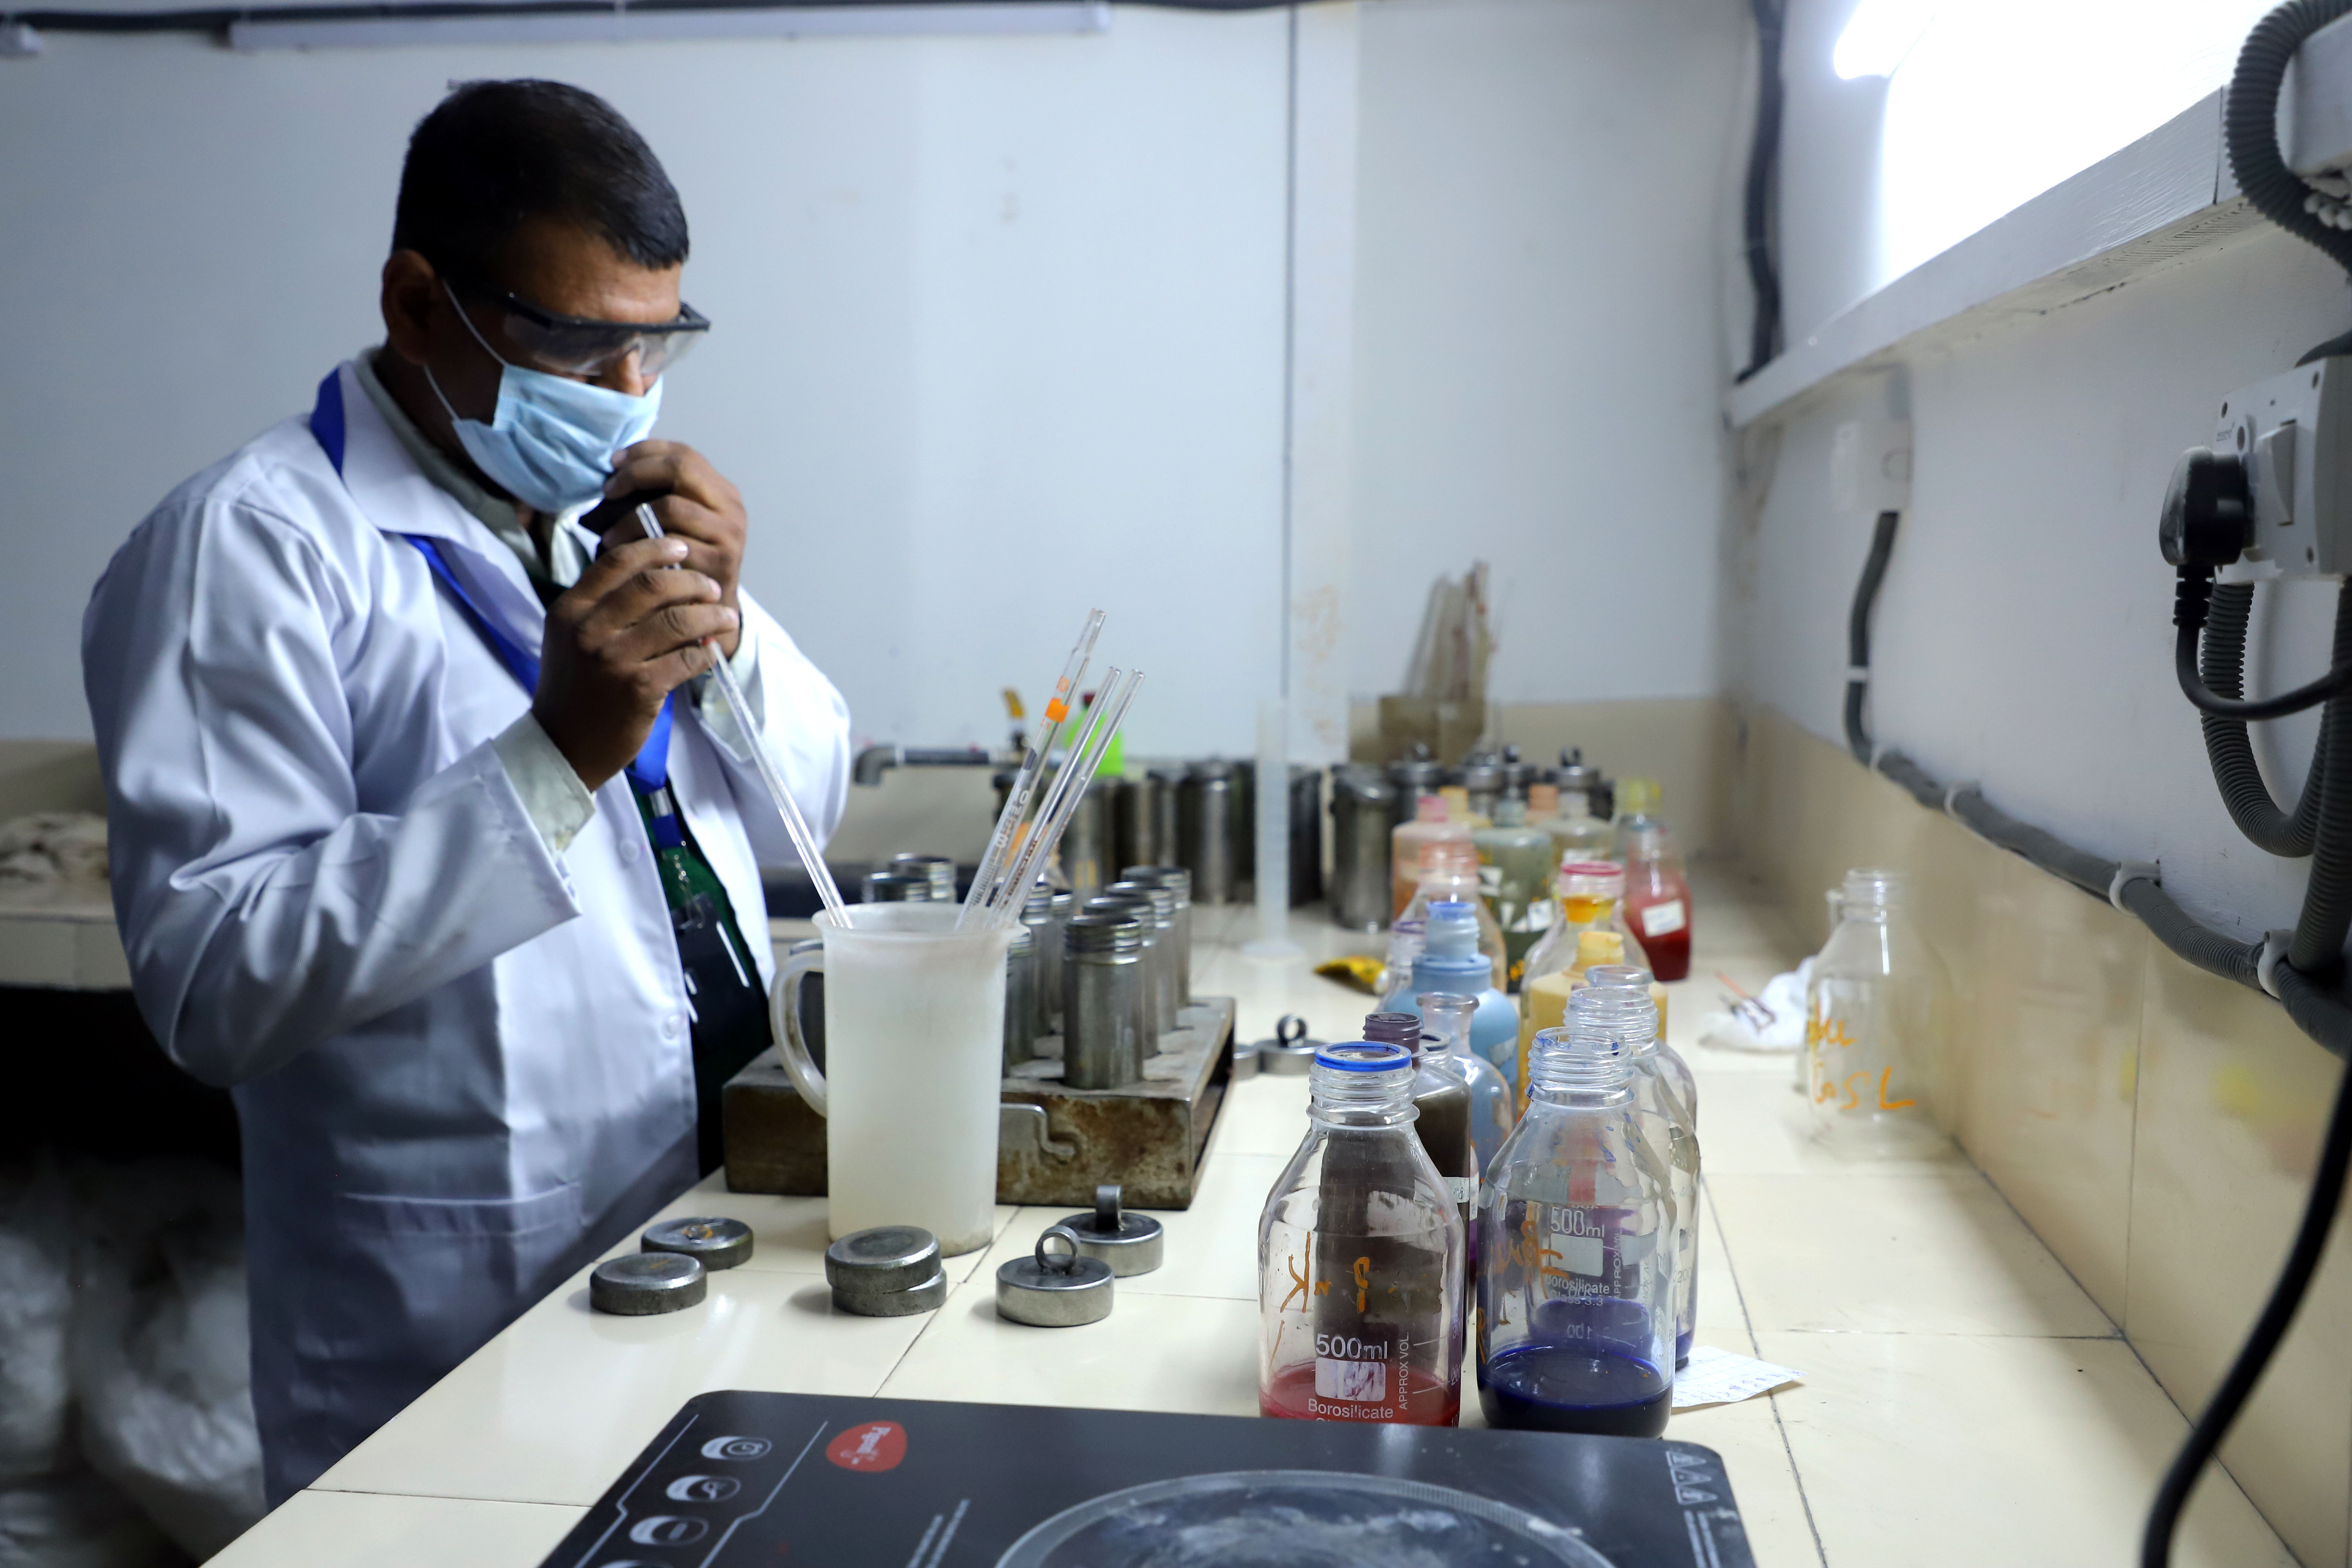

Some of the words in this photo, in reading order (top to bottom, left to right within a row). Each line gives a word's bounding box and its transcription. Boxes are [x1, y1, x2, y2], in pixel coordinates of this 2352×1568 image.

[1551, 1206, 1605, 1238] 500ml
[1315, 1333, 1388, 1360] 500ml
[1399, 1332, 1409, 1358] VOL.
[1399, 1360, 1409, 1410] APPROX
[1308, 1398, 1394, 1419] Borosilicate
